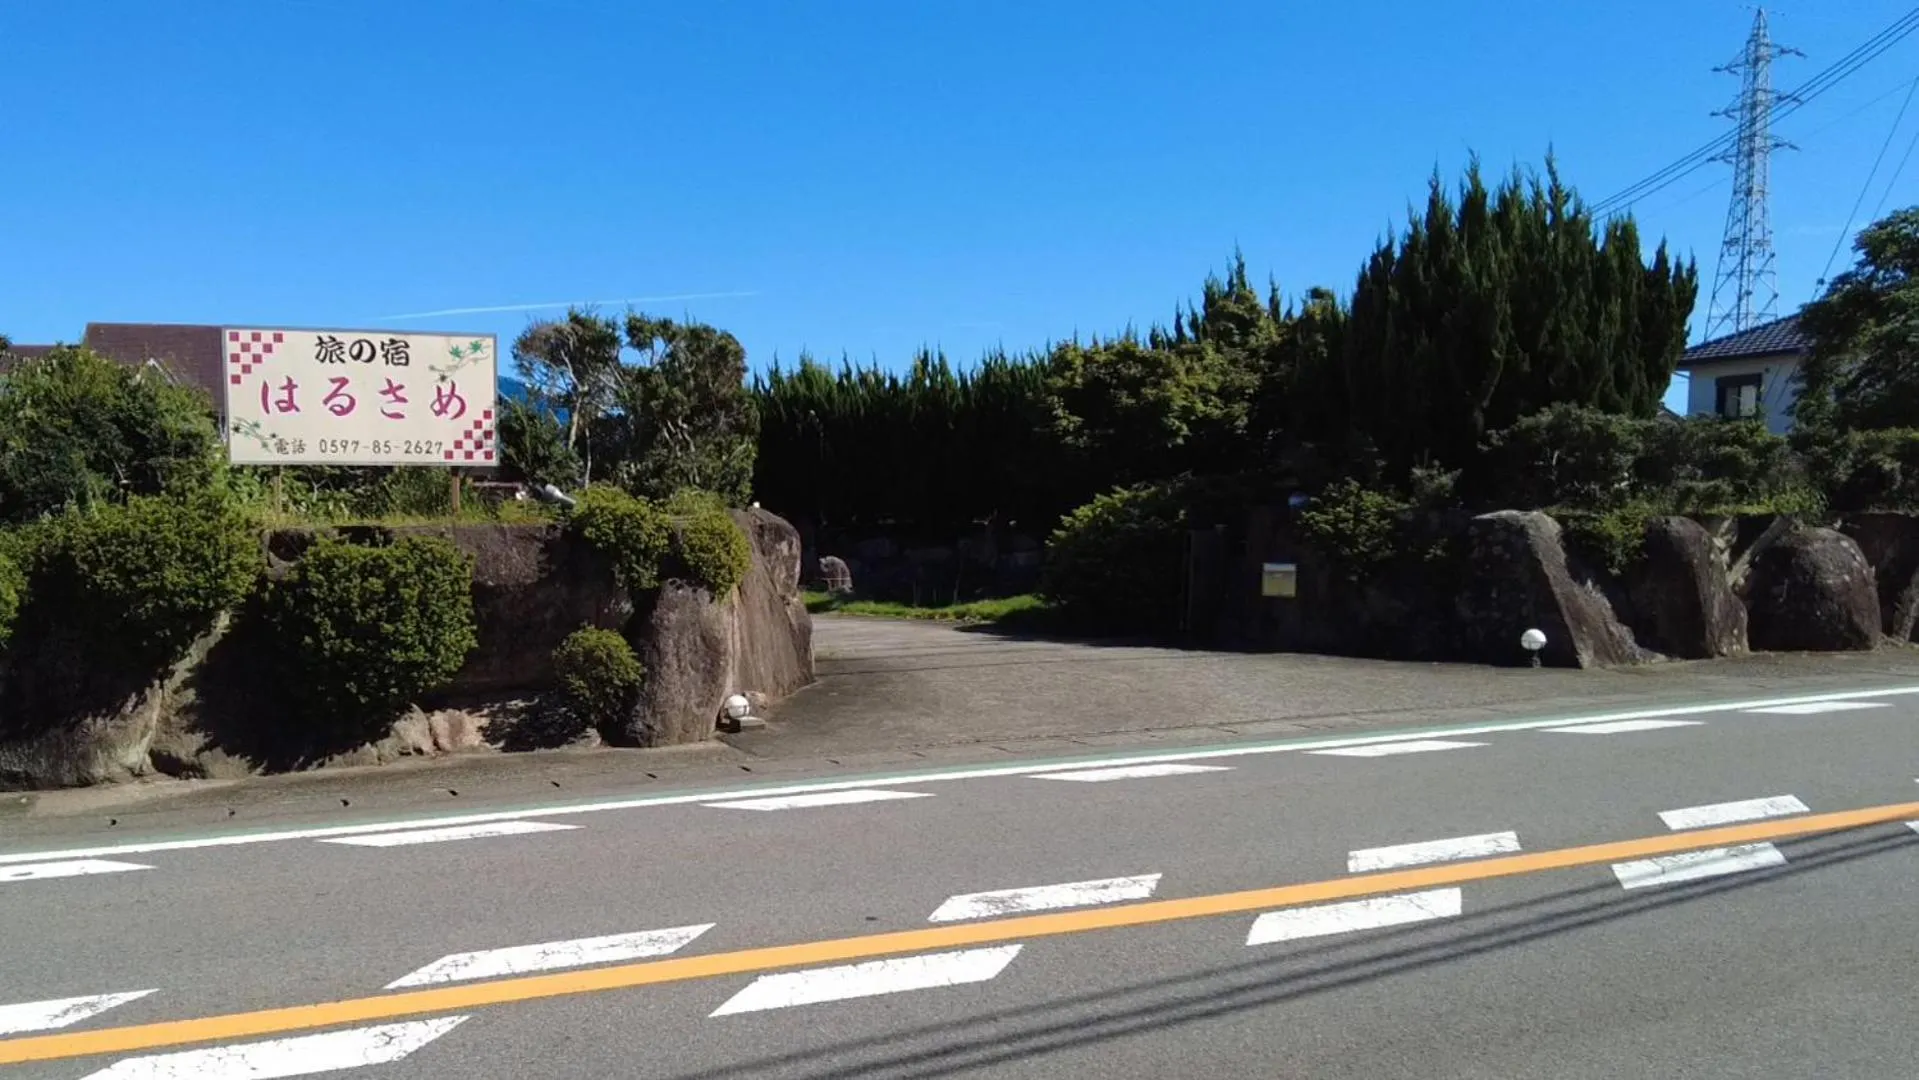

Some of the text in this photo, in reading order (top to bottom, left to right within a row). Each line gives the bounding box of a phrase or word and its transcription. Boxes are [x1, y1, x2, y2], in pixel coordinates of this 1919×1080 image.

[315, 335, 411, 367] 旅の宿
[261, 375, 468, 420] はるさめ
[274, 438, 443, 454] 電話 0597-85-2627
